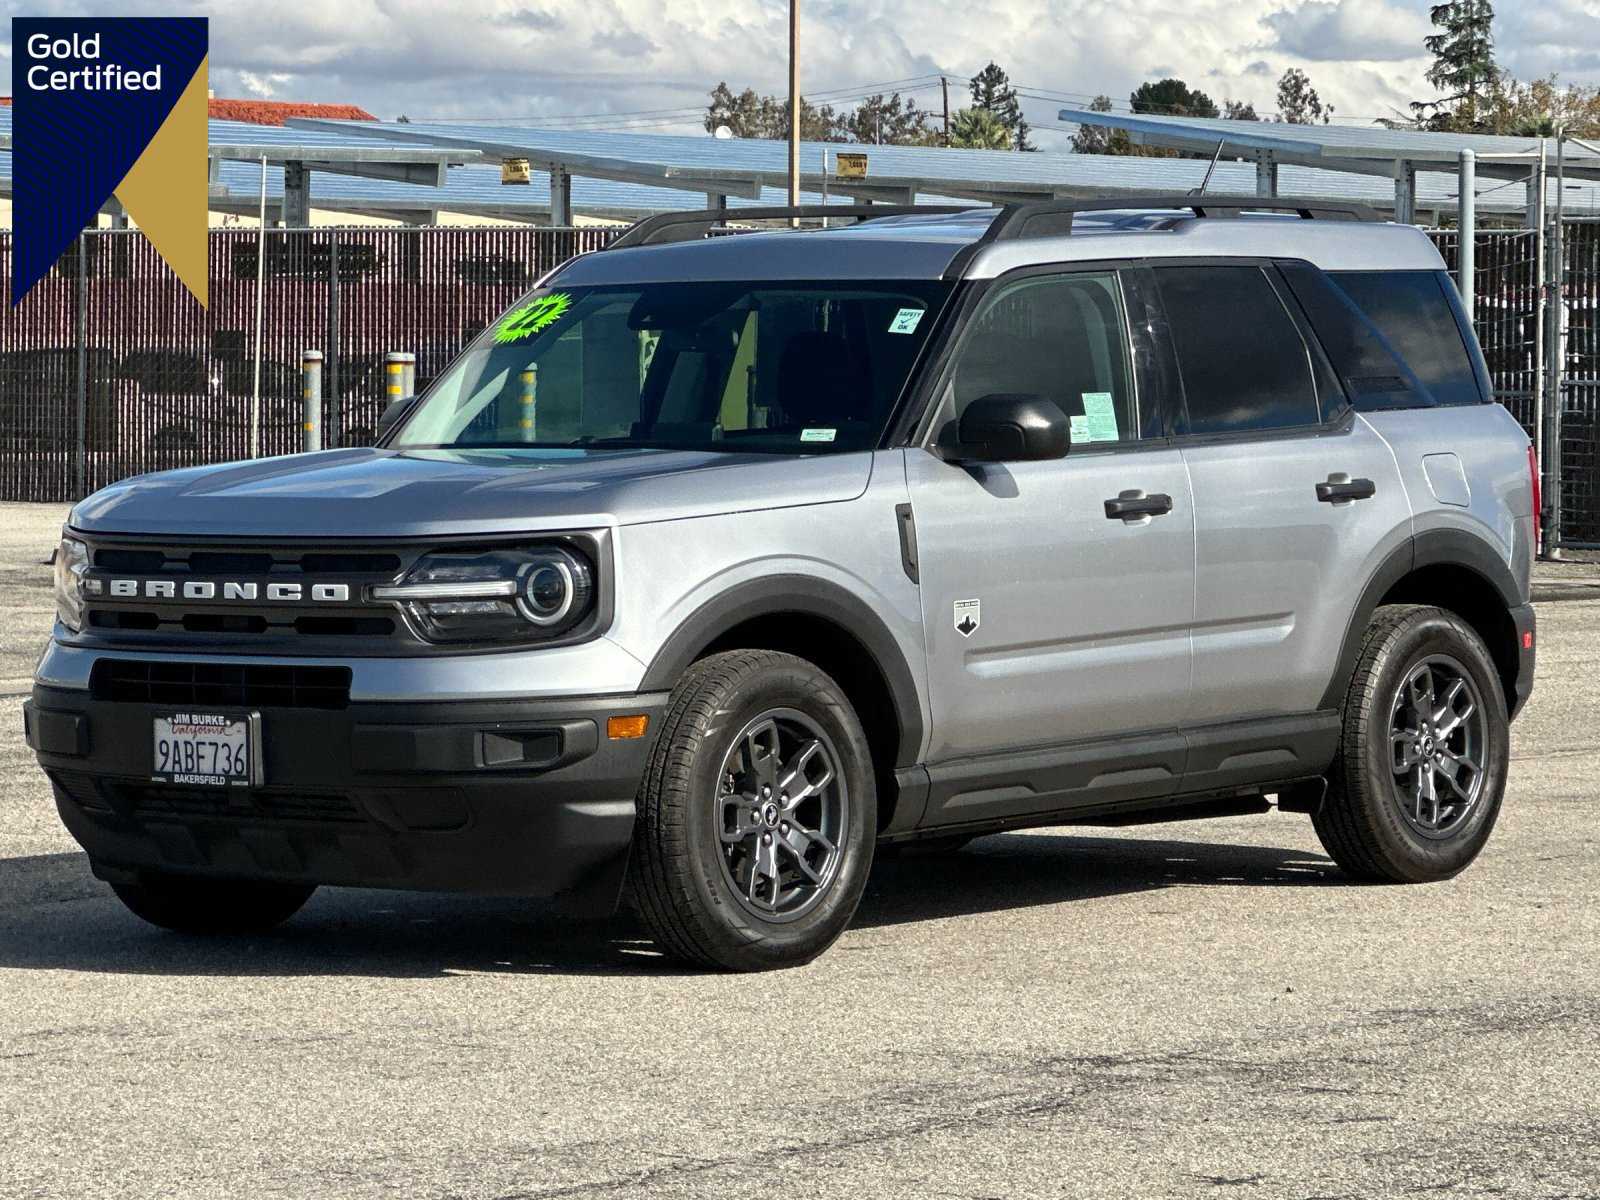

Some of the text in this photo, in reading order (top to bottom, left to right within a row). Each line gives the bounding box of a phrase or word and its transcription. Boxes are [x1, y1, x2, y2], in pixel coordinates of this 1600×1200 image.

[110, 580, 349, 601] BRONCO
[174, 713, 225, 726] JIM BURKE
[171, 724, 233, 740] California
[159, 739, 245, 775] 9ABF736
[174, 774, 226, 786] BAKERSFIELD
